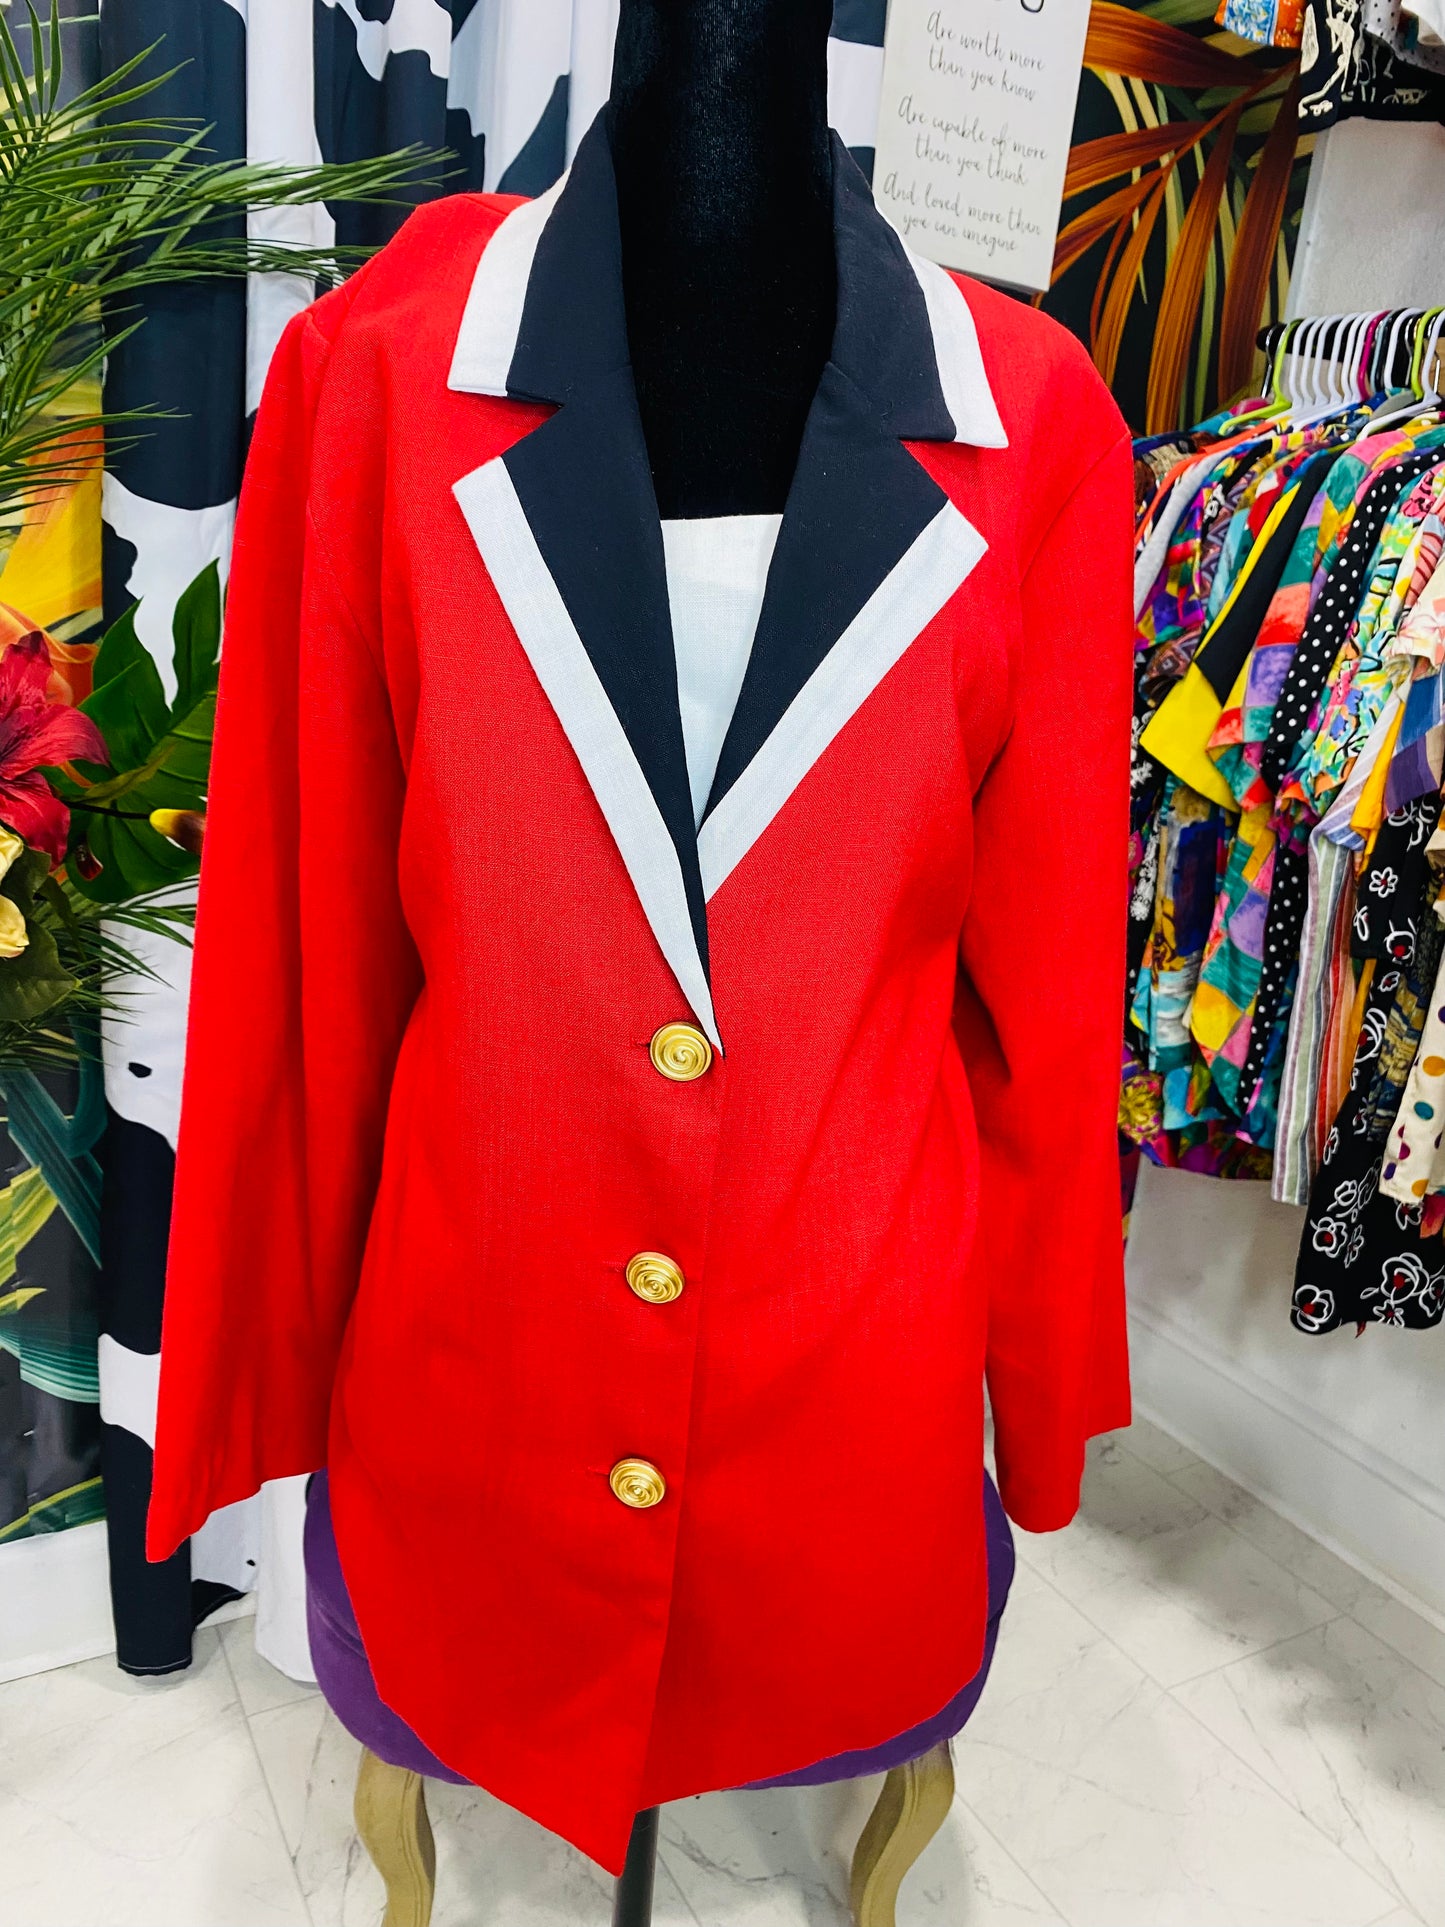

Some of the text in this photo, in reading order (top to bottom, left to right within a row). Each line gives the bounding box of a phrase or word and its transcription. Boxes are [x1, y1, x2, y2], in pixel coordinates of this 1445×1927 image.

[927, 10, 1045, 71] Are worth more
[928, 45, 1036, 101] than you know
[898, 95, 1048, 160] Are capable of more
[915, 133, 1029, 186] than you think
[883, 172, 1041, 236] And loved more than
[903, 214, 1017, 256] you can imagine
